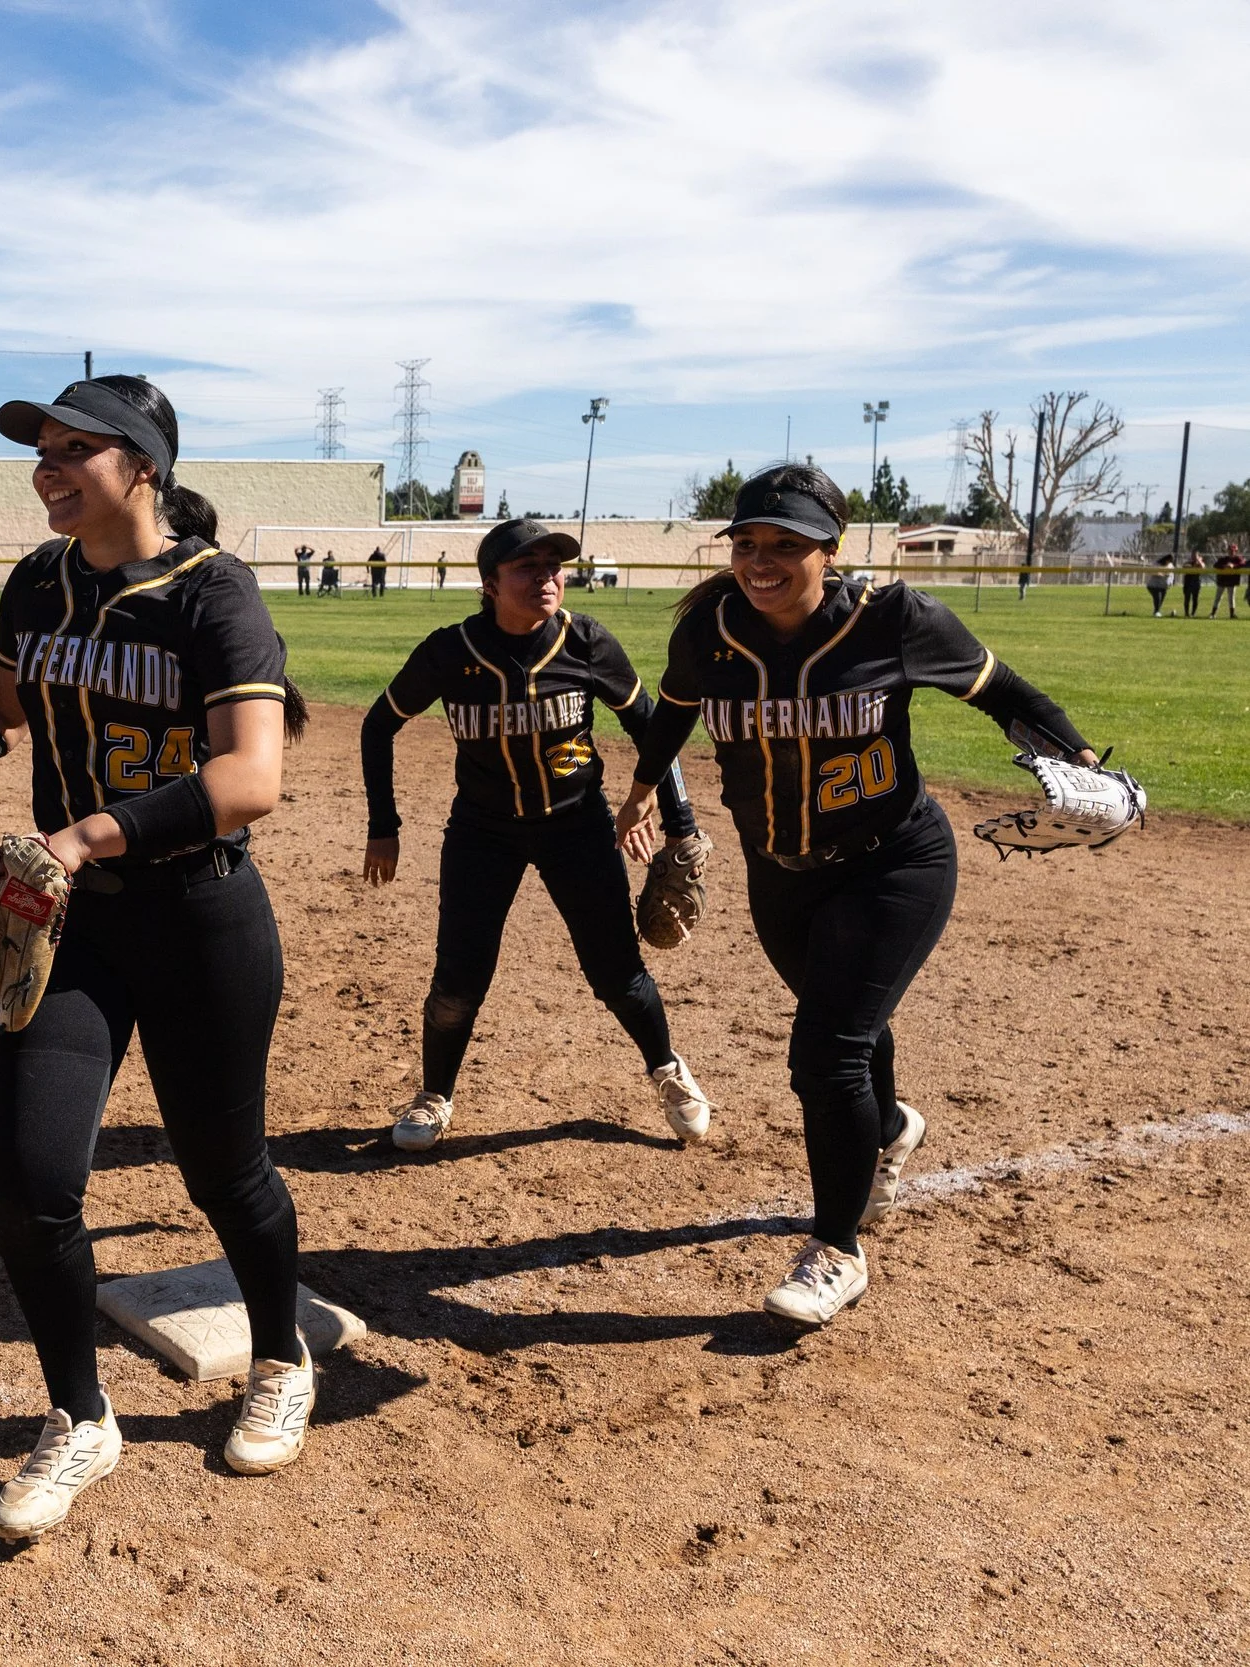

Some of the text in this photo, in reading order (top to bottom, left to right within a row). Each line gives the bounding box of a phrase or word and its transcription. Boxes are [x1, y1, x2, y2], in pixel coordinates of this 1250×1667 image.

[28, 633, 183, 711] FERNANDO
[741, 689, 889, 740] FERNANDO
[104, 722, 198, 793] 24
[817, 735, 898, 813] 20
